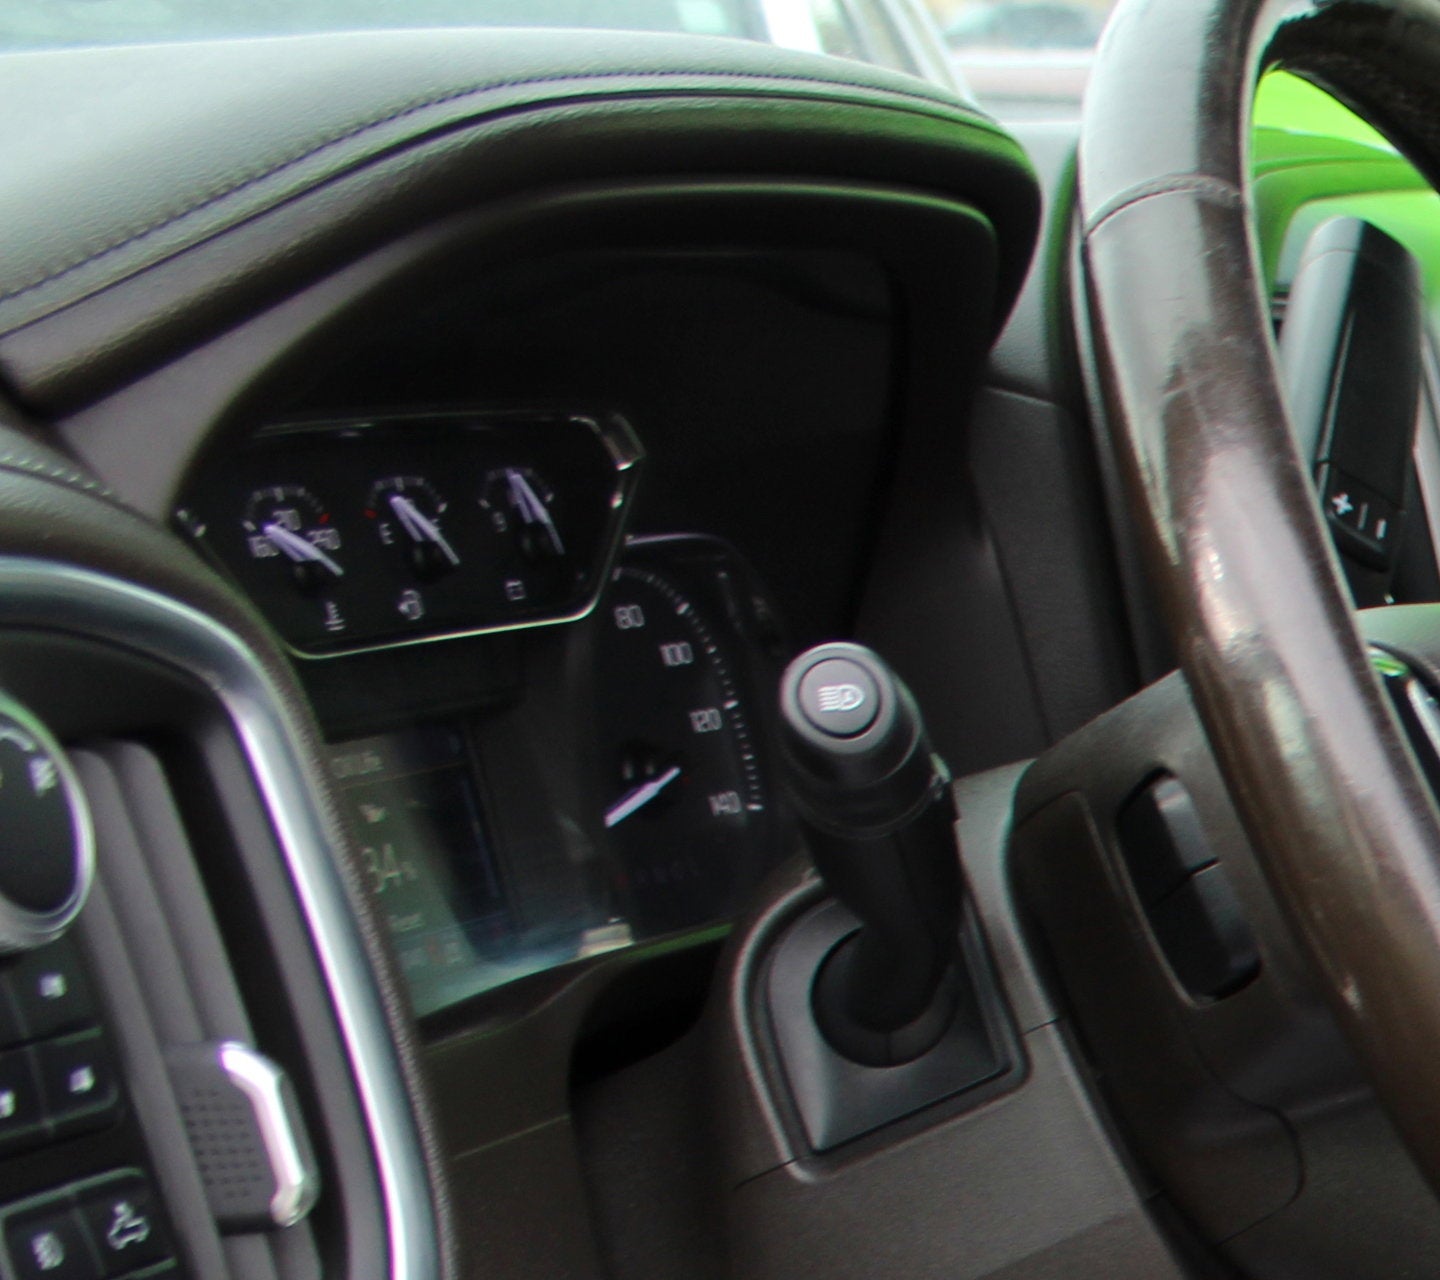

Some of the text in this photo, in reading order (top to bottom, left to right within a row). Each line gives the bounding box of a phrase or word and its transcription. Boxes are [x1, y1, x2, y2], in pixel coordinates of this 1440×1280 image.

[614, 605, 645, 629] 80
[660, 641, 693, 666] 100
[689, 708, 723, 732] 120
